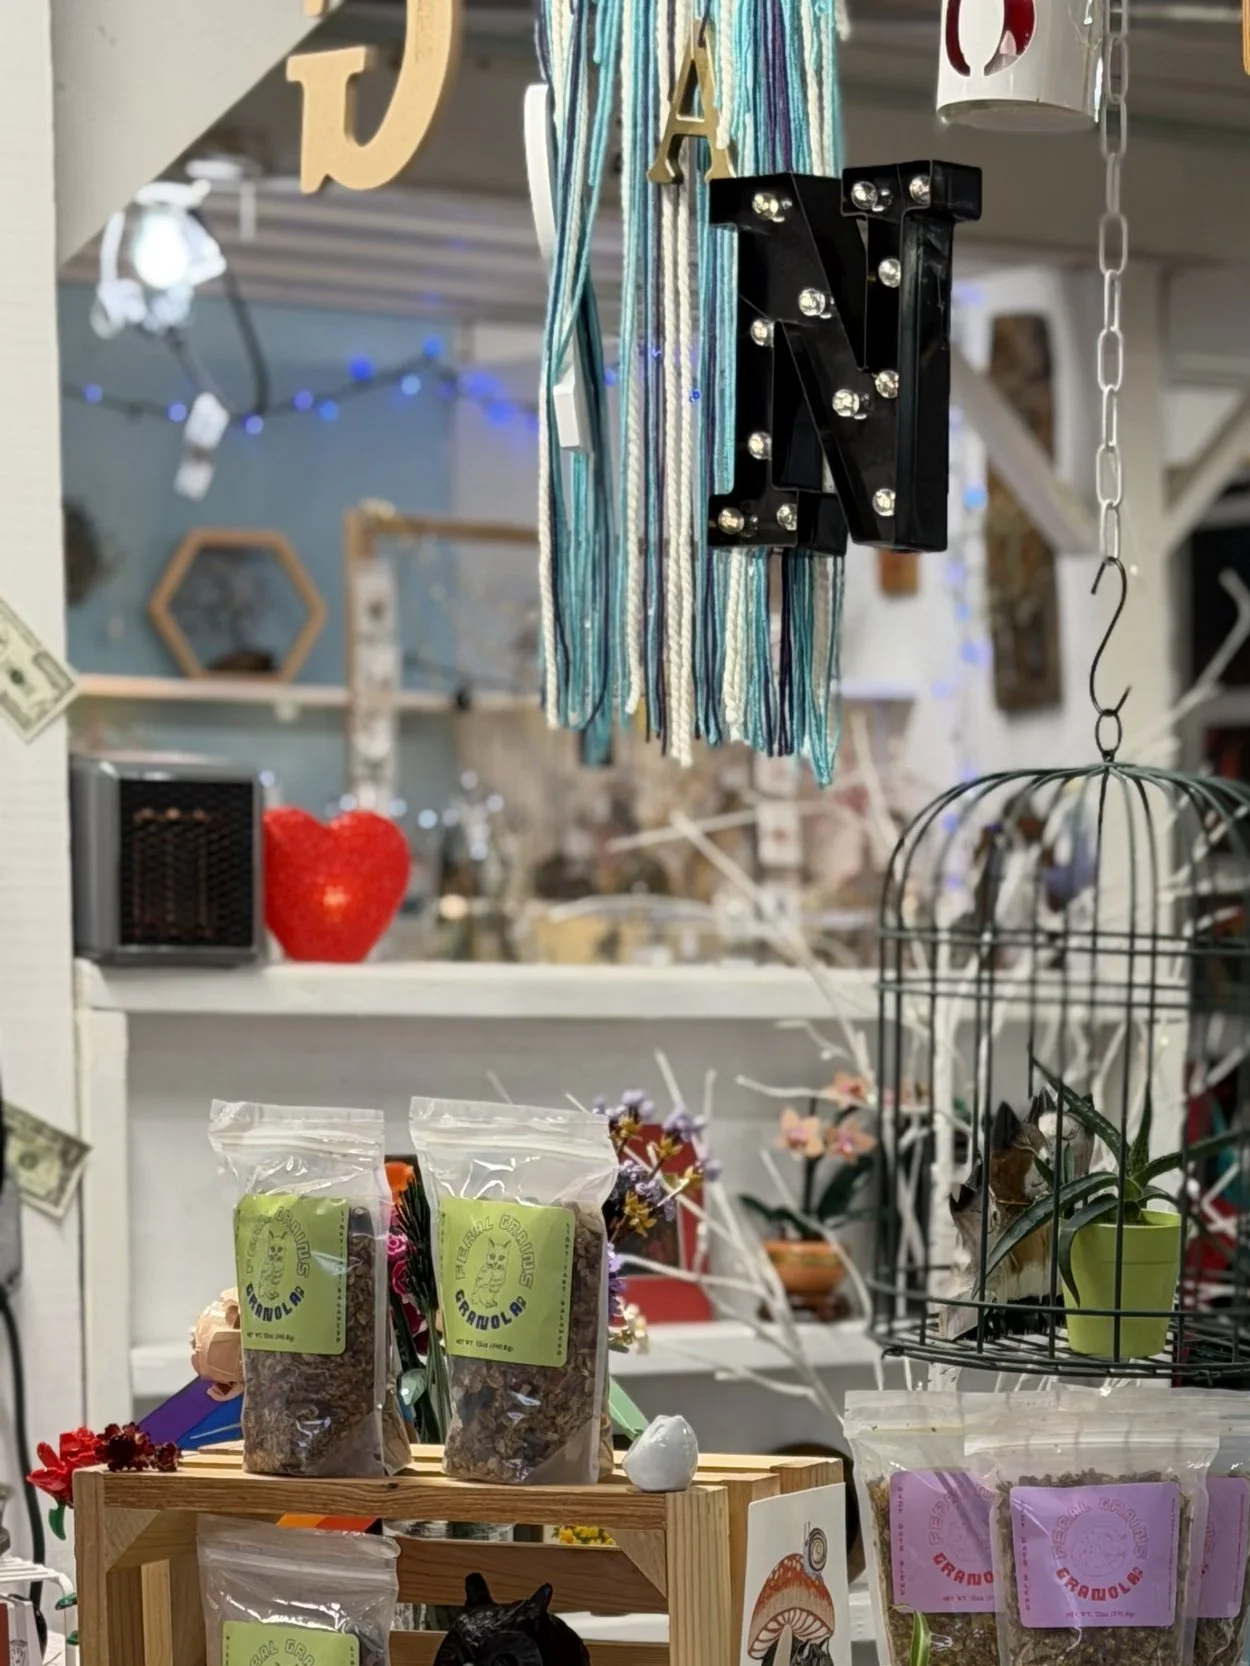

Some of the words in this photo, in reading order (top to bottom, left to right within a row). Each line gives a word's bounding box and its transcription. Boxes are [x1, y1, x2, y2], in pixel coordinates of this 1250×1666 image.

[455, 1216, 494, 1280] FERAL
[499, 1214, 536, 1289] GRAINS
[455, 1289, 526, 1331] GRANOLA
[1052, 1501, 1091, 1560] FERAL
[1098, 1497, 1149, 1559] GRAINS
[933, 1552, 994, 1586] GRANO
[1056, 1567, 1142, 1600] GRANOLA
